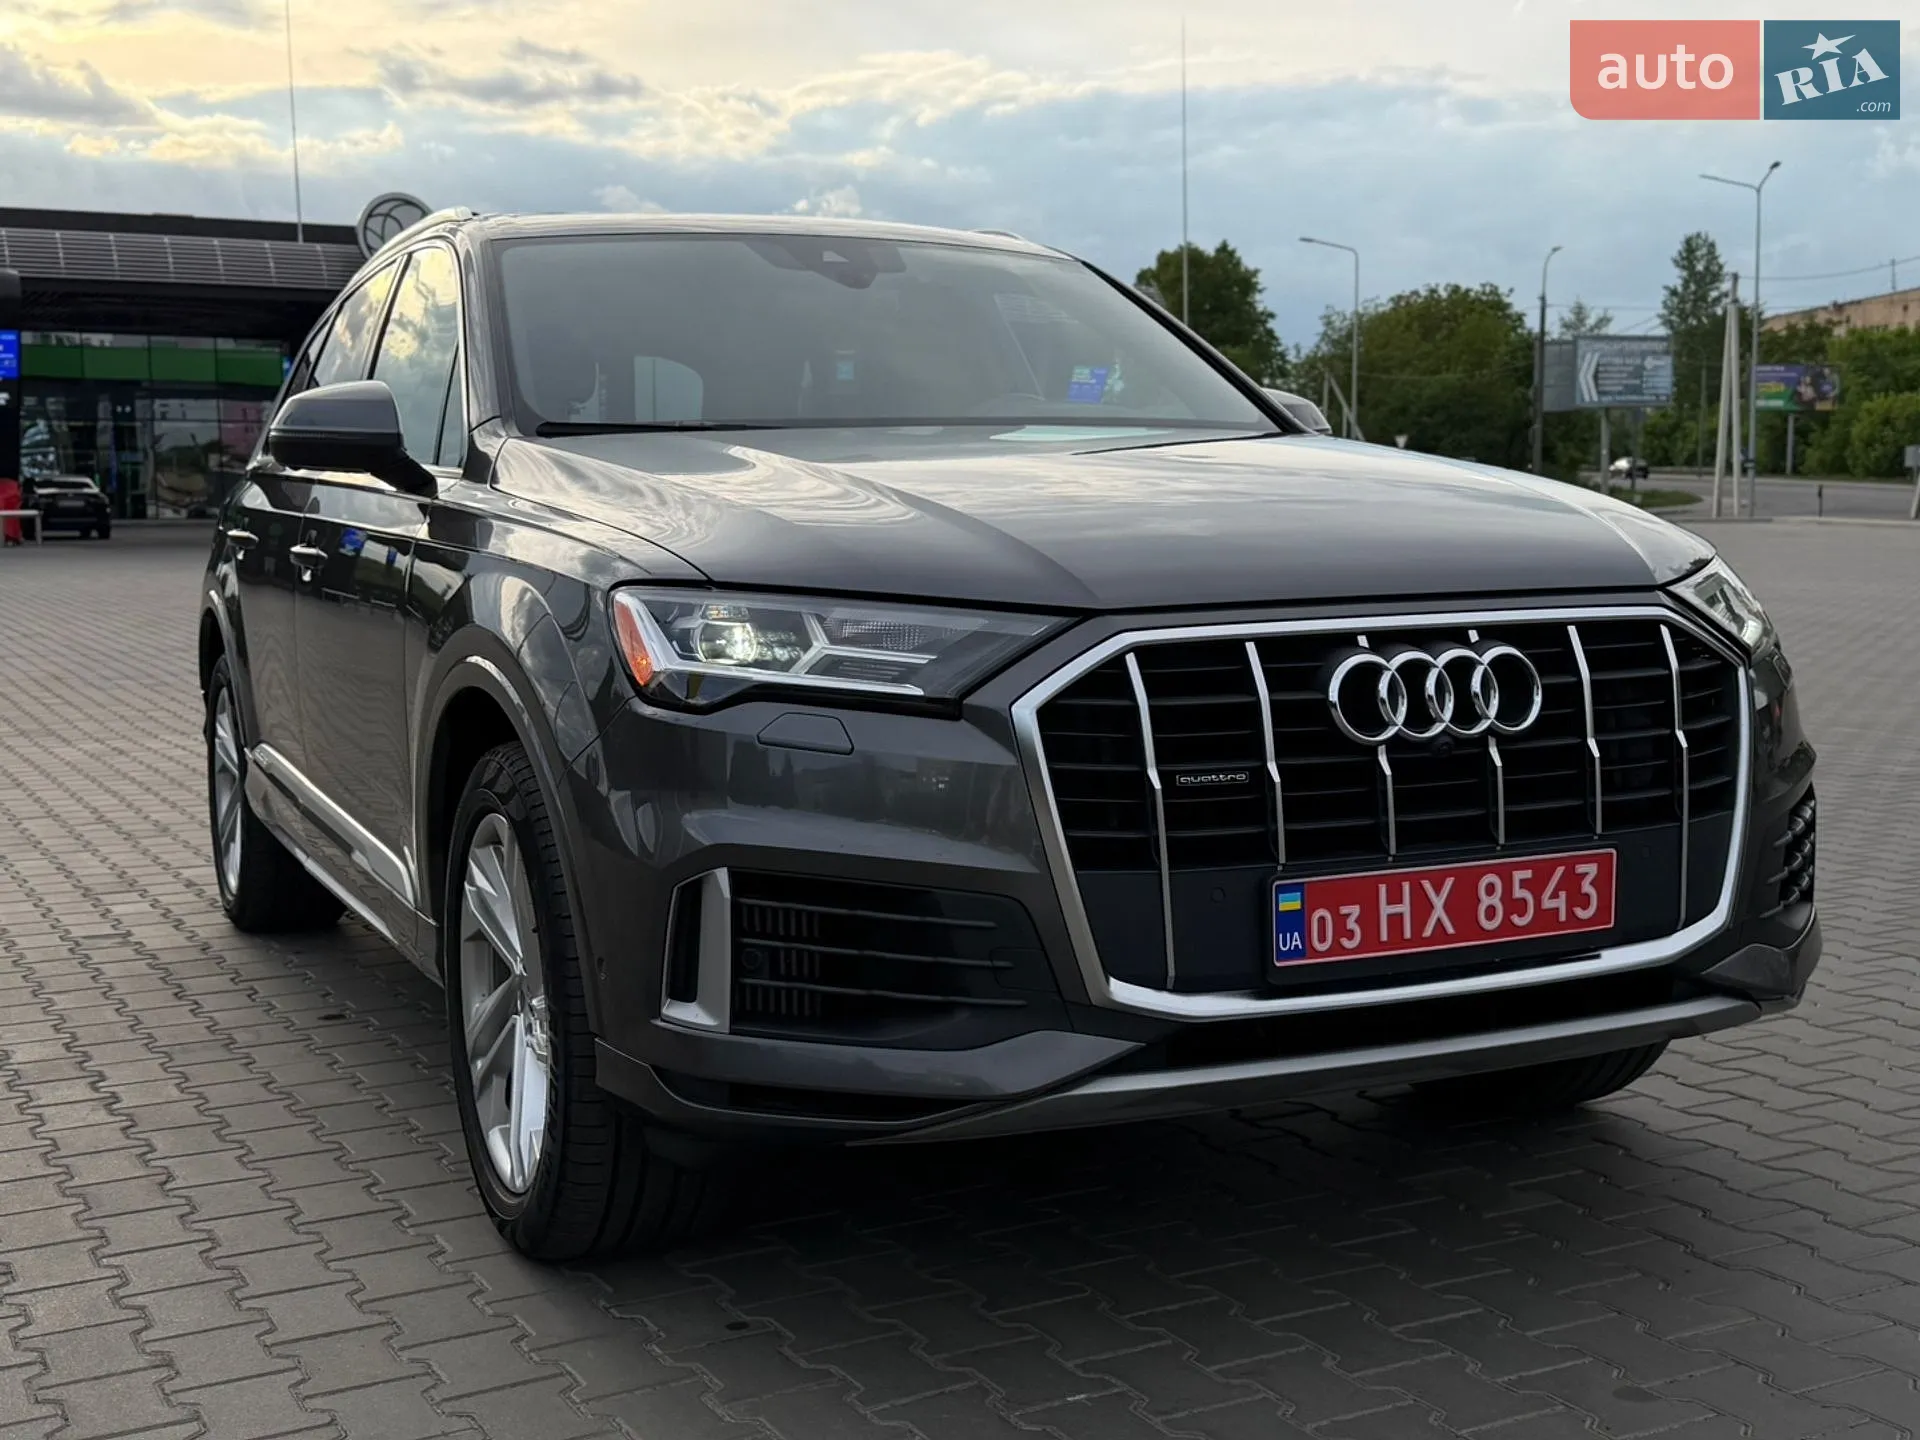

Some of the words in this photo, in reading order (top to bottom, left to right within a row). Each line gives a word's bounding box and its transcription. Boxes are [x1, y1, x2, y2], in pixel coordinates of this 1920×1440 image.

[1180, 773, 1247, 784] quattro
[1310, 904, 1361, 952] 03
[1377, 877, 1457, 942] HX
[1477, 863, 1599, 931] 8543
[1278, 931, 1303, 951] UA
